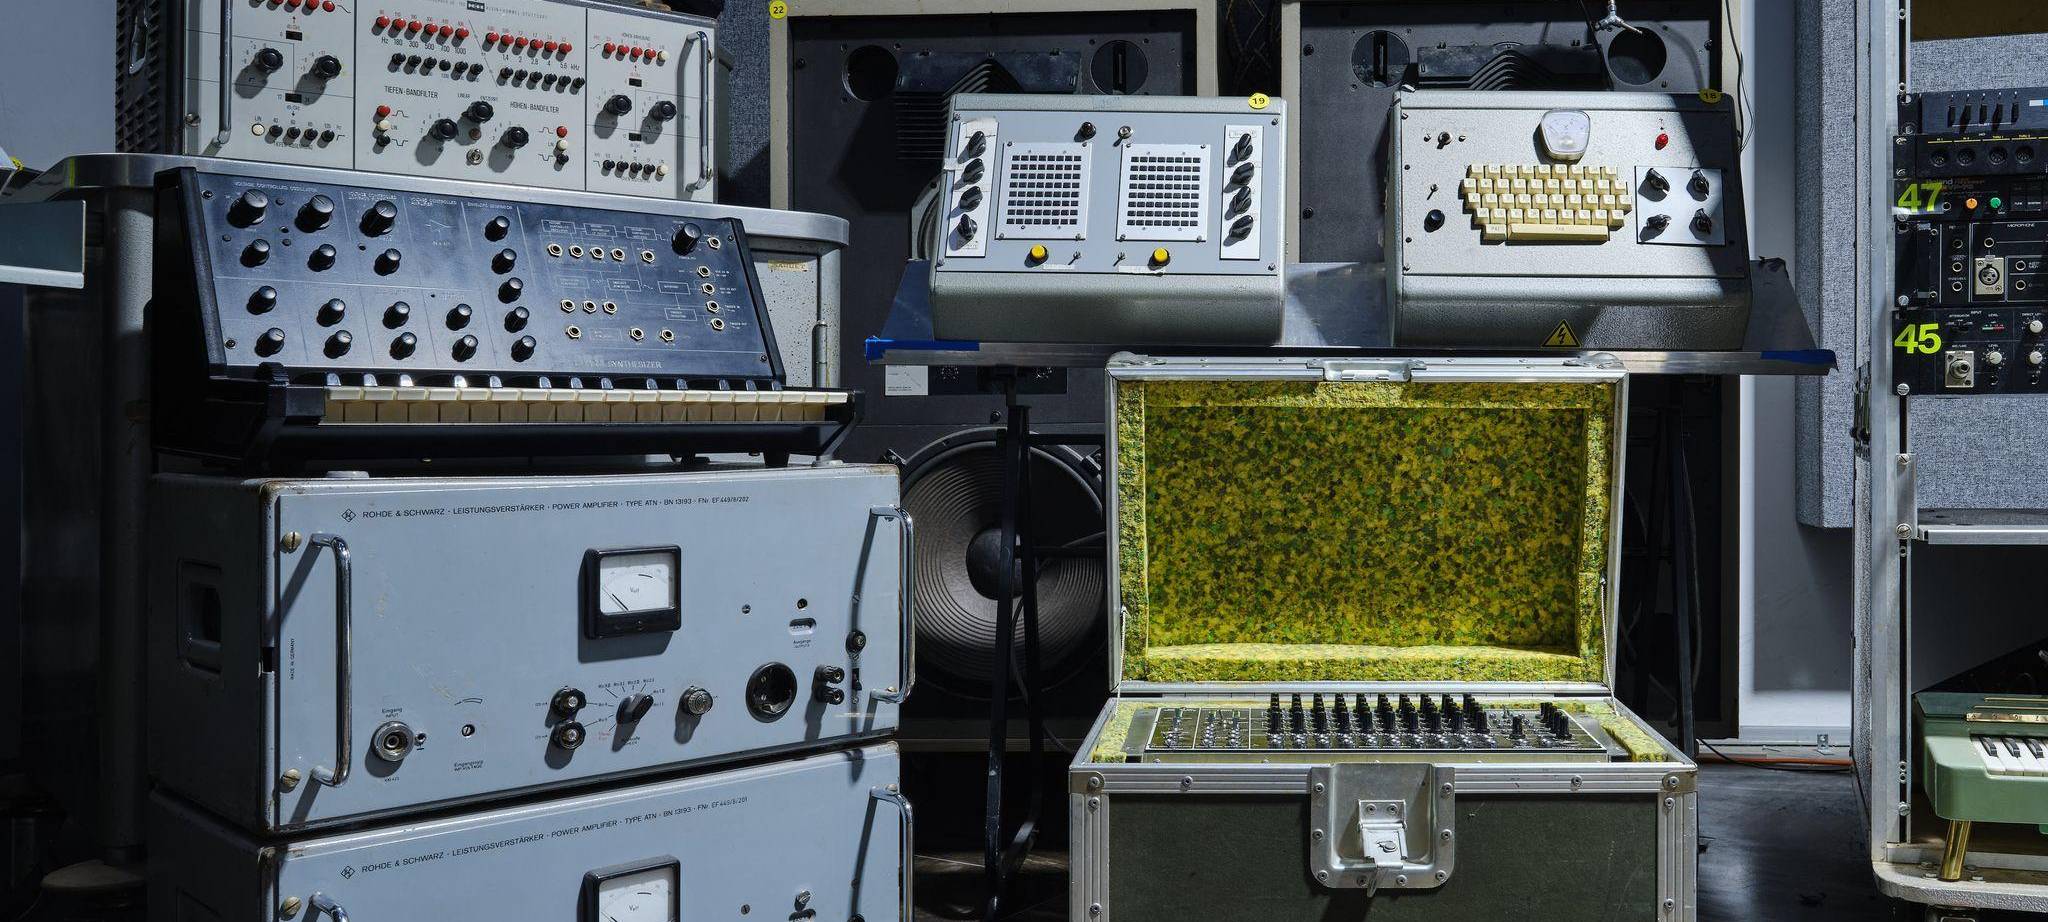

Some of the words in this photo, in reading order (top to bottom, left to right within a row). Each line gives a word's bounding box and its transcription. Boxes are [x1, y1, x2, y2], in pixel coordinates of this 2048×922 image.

[773, 6, 784, 14] 22
[381, 36, 389, 44] Hz
[409, 40, 419, 48] 300
[425, 43, 435, 51] 500
[455, 47, 467, 55] 1000
[1252, 97, 1265, 105] 19
[1897, 183, 1943, 212] 47
[1894, 323, 1942, 354] 45
[607, 359, 662, 369] SYNTHESIZER
[362, 511, 393, 519] ROHDE
[403, 508, 445, 517] SCHWARZ
[453, 503, 545, 515] LEISTUNGSVERSTÄRKER
[582, 501, 618, 509] AMPLIFIER
[361, 861, 392, 874] ROHDE
[402, 852, 445, 866] SCHWARZ
[551, 827, 580, 839] POWER
[581, 820, 618, 833] AMPLIFIER
[625, 816, 642, 825] TYPE
[644, 813, 657, 821] ATN
